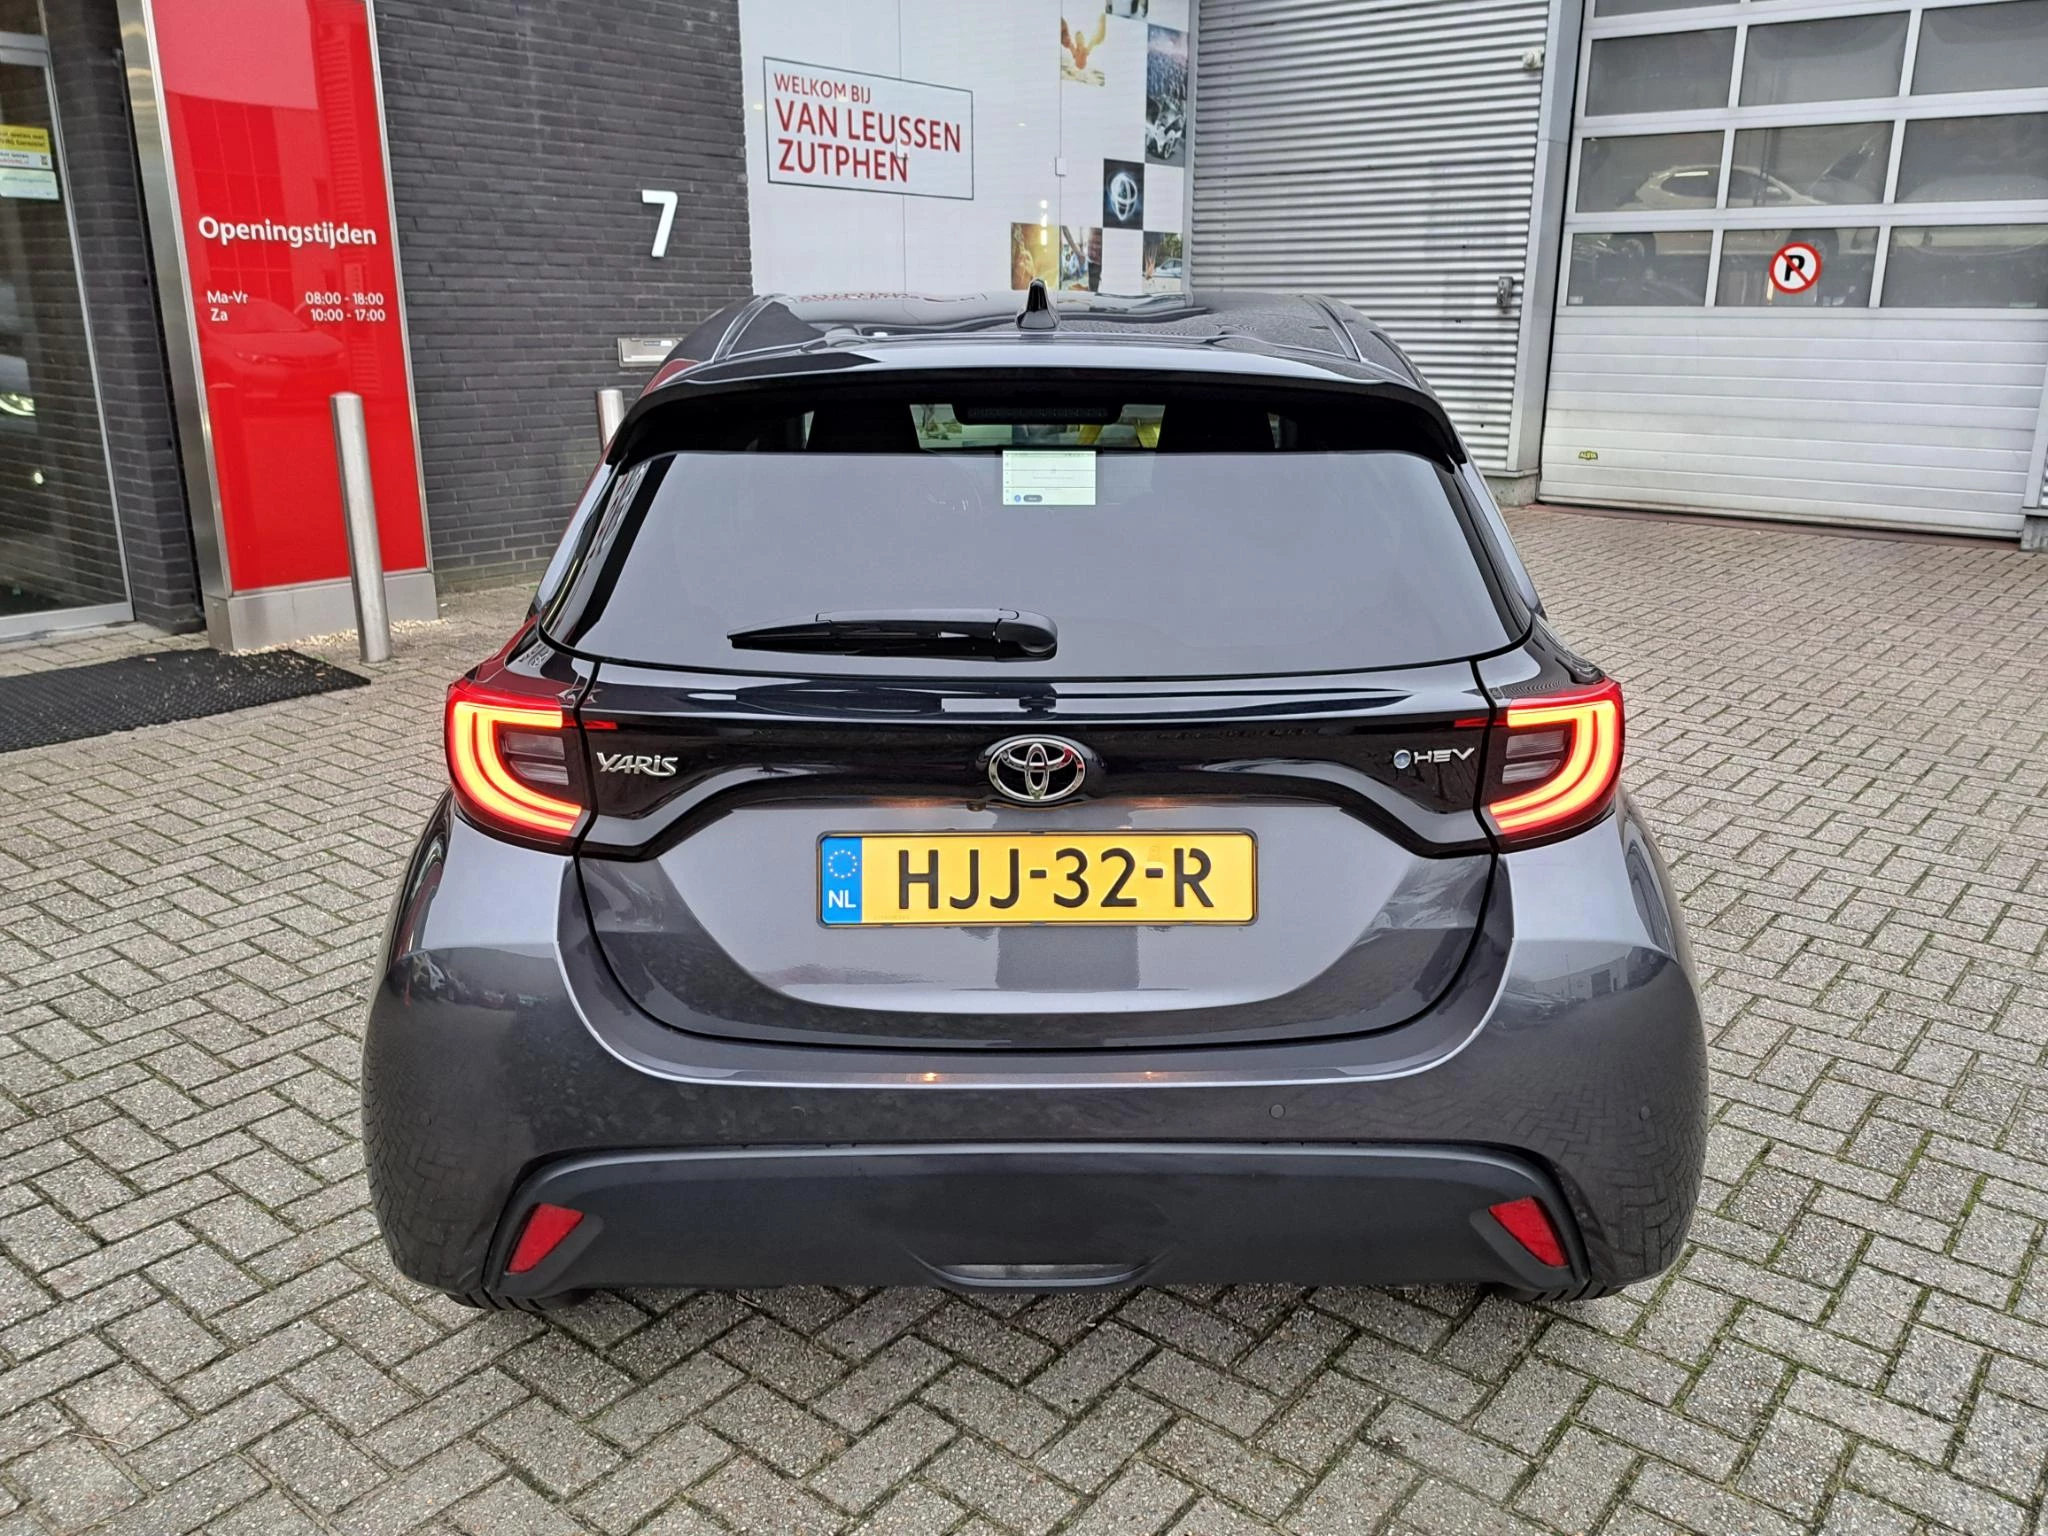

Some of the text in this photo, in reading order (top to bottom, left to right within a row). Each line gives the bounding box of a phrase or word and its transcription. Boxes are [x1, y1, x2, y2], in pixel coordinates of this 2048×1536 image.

[774, 73, 871, 104] WELKOM BIJ
[775, 98, 961, 153] VAN LEUSSEN
[778, 137, 908, 183] ZUTPHEN
[198, 216, 377, 249] Openingstijden
[641, 188, 679, 258] 7
[207, 290, 249, 305] Ma-Vr
[304, 291, 342, 306] 08:00
[352, 292, 384, 306] 18:00
[210, 308, 229, 322] Za
[310, 308, 344, 322] 10:00
[354, 309, 386, 322] 17:00
[1413, 747, 1475, 765] HEV
[897, 847, 1215, 910] HJJ-32-R
[828, 889, 857, 909] NL
